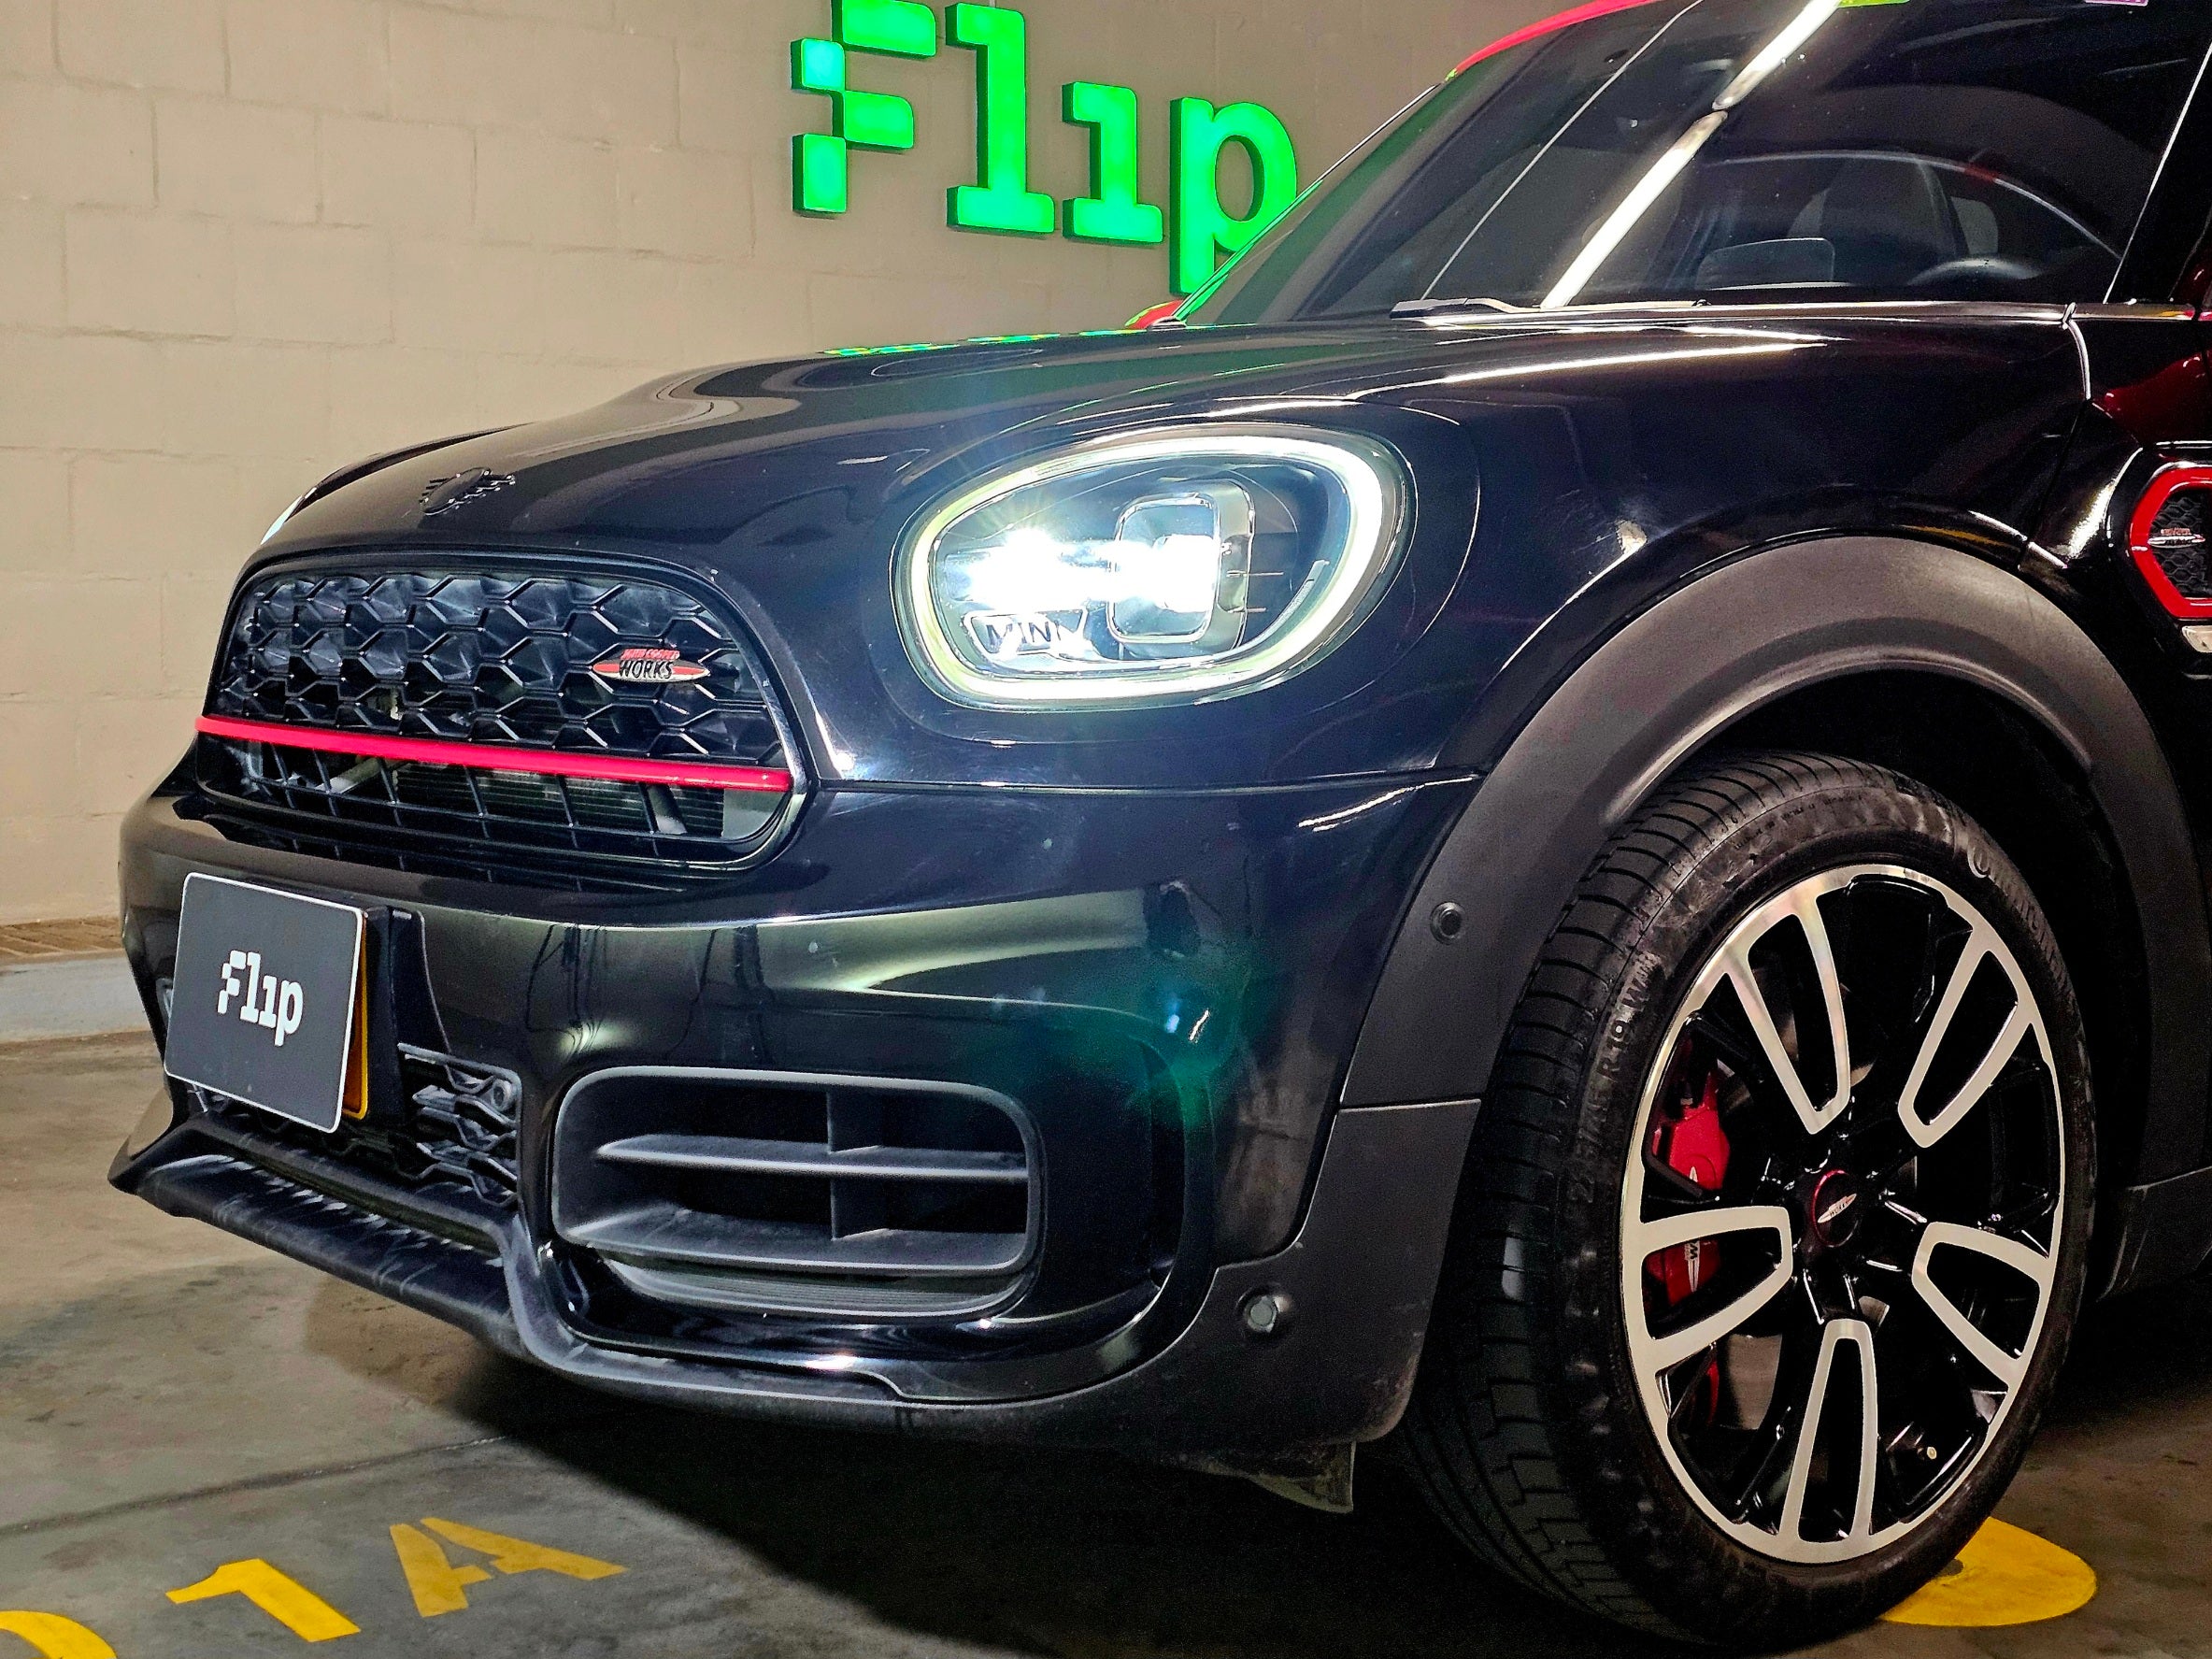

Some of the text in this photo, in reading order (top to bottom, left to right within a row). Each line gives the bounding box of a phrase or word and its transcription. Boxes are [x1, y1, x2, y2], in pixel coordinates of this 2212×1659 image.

[792, 0, 1298, 295] Flip
[619, 659, 675, 679] WORKS
[217, 950, 304, 1047] Flip
